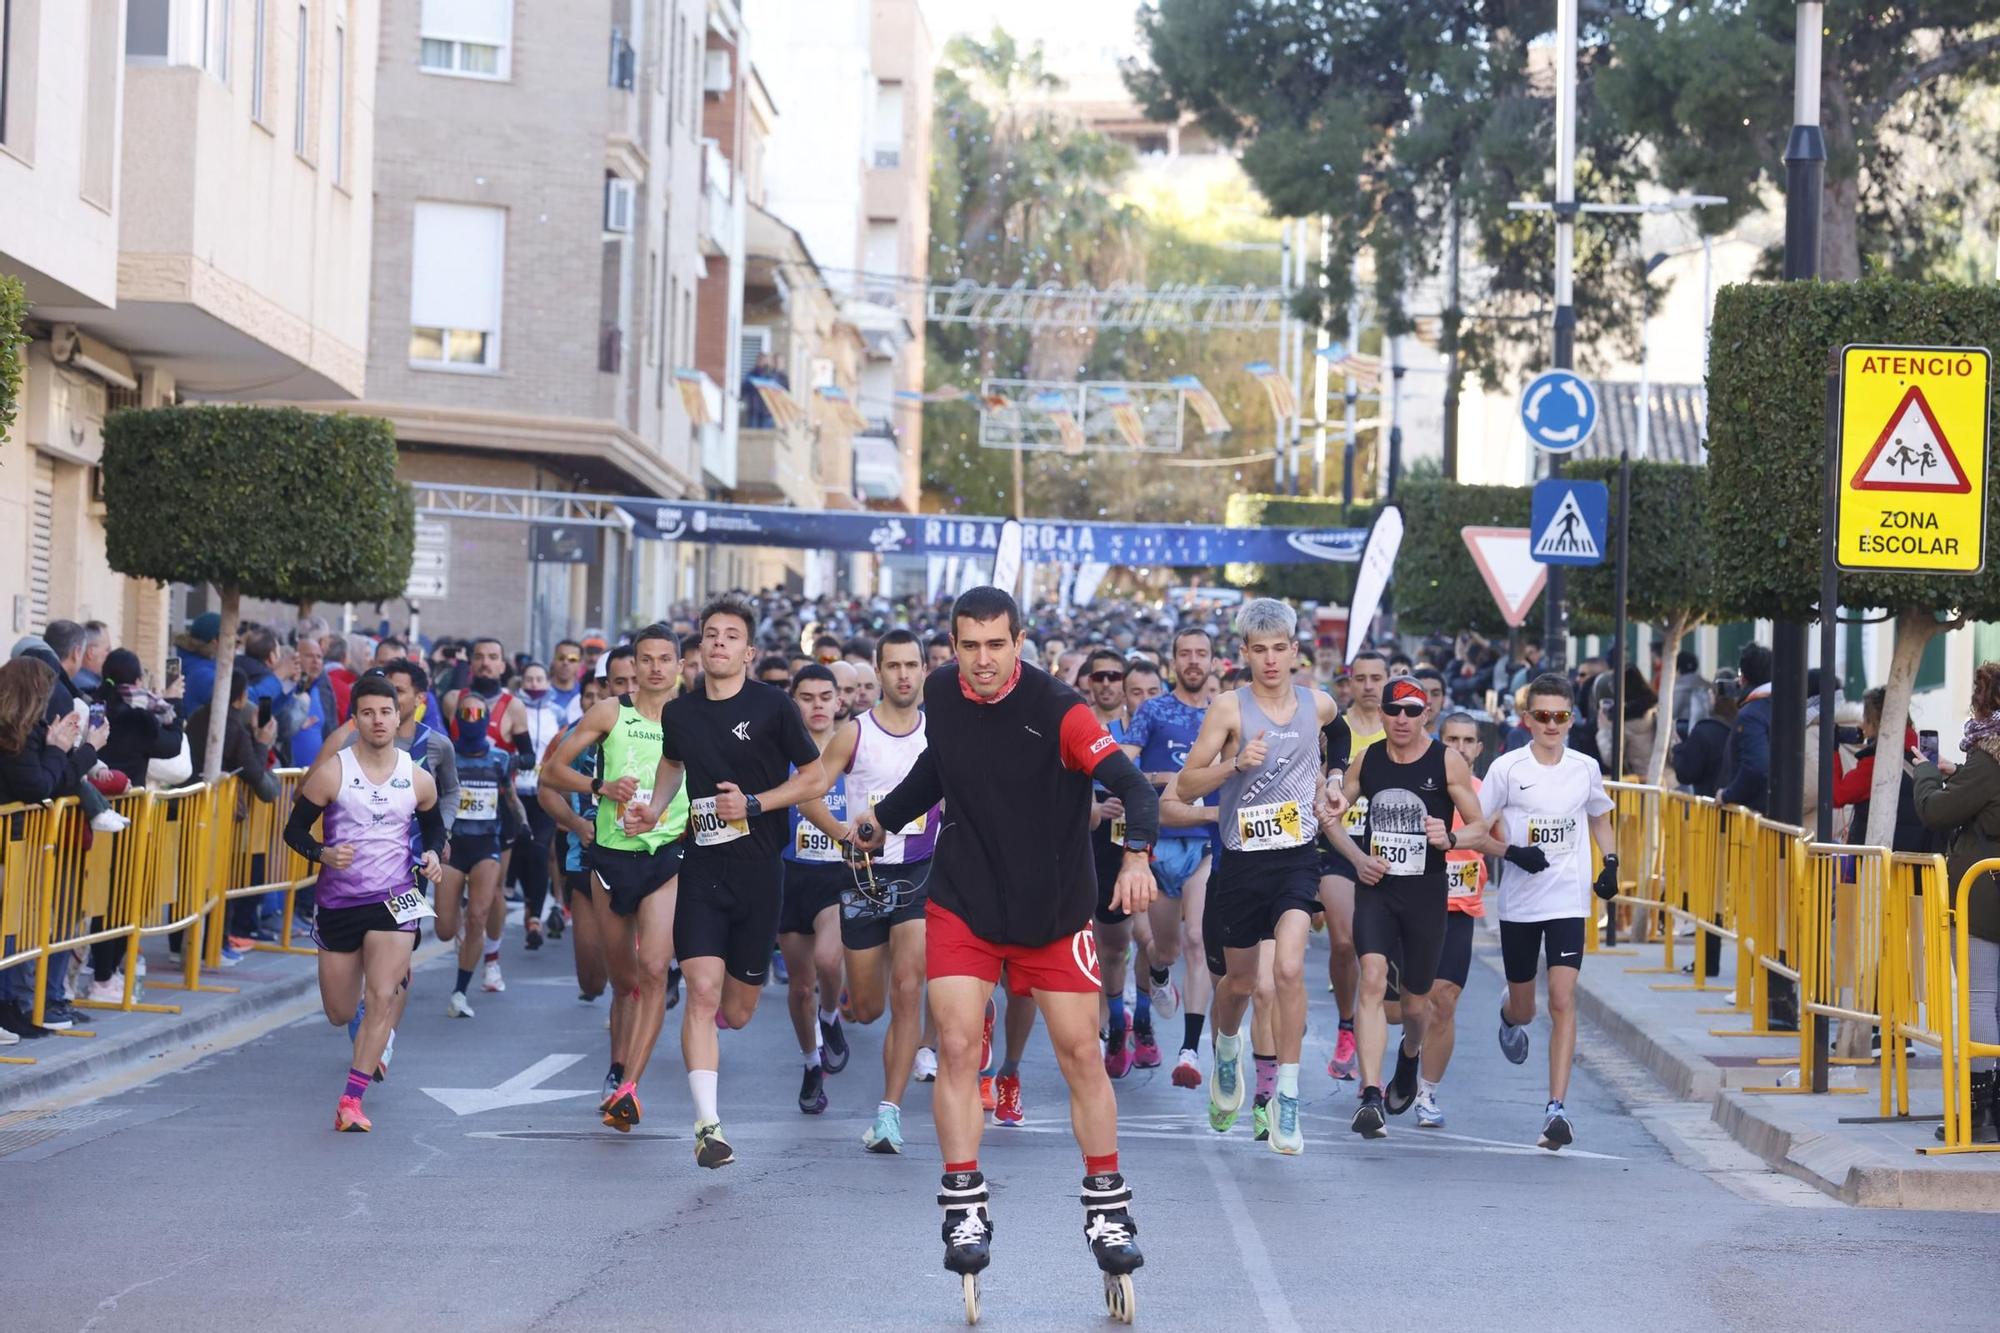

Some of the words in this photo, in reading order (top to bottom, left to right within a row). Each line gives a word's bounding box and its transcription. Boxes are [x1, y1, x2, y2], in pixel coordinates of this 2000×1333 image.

[1861, 354, 1973, 377] ATENCIÓ
[1880, 510, 1939, 529] ZONA
[924, 519, 998, 549] RIBA
[1022, 524, 1095, 551] ROJA
[1858, 535, 1959, 555] ESCOLAR
[627, 729, 664, 742] LASANS
[1242, 755, 1292, 804] SILLA
[692, 812, 728, 833] 6008
[1244, 818, 1283, 839] 6013
[1531, 827, 1565, 843] 6031
[1374, 844, 1407, 864] 1630
[1447, 873, 1465, 888] 31
